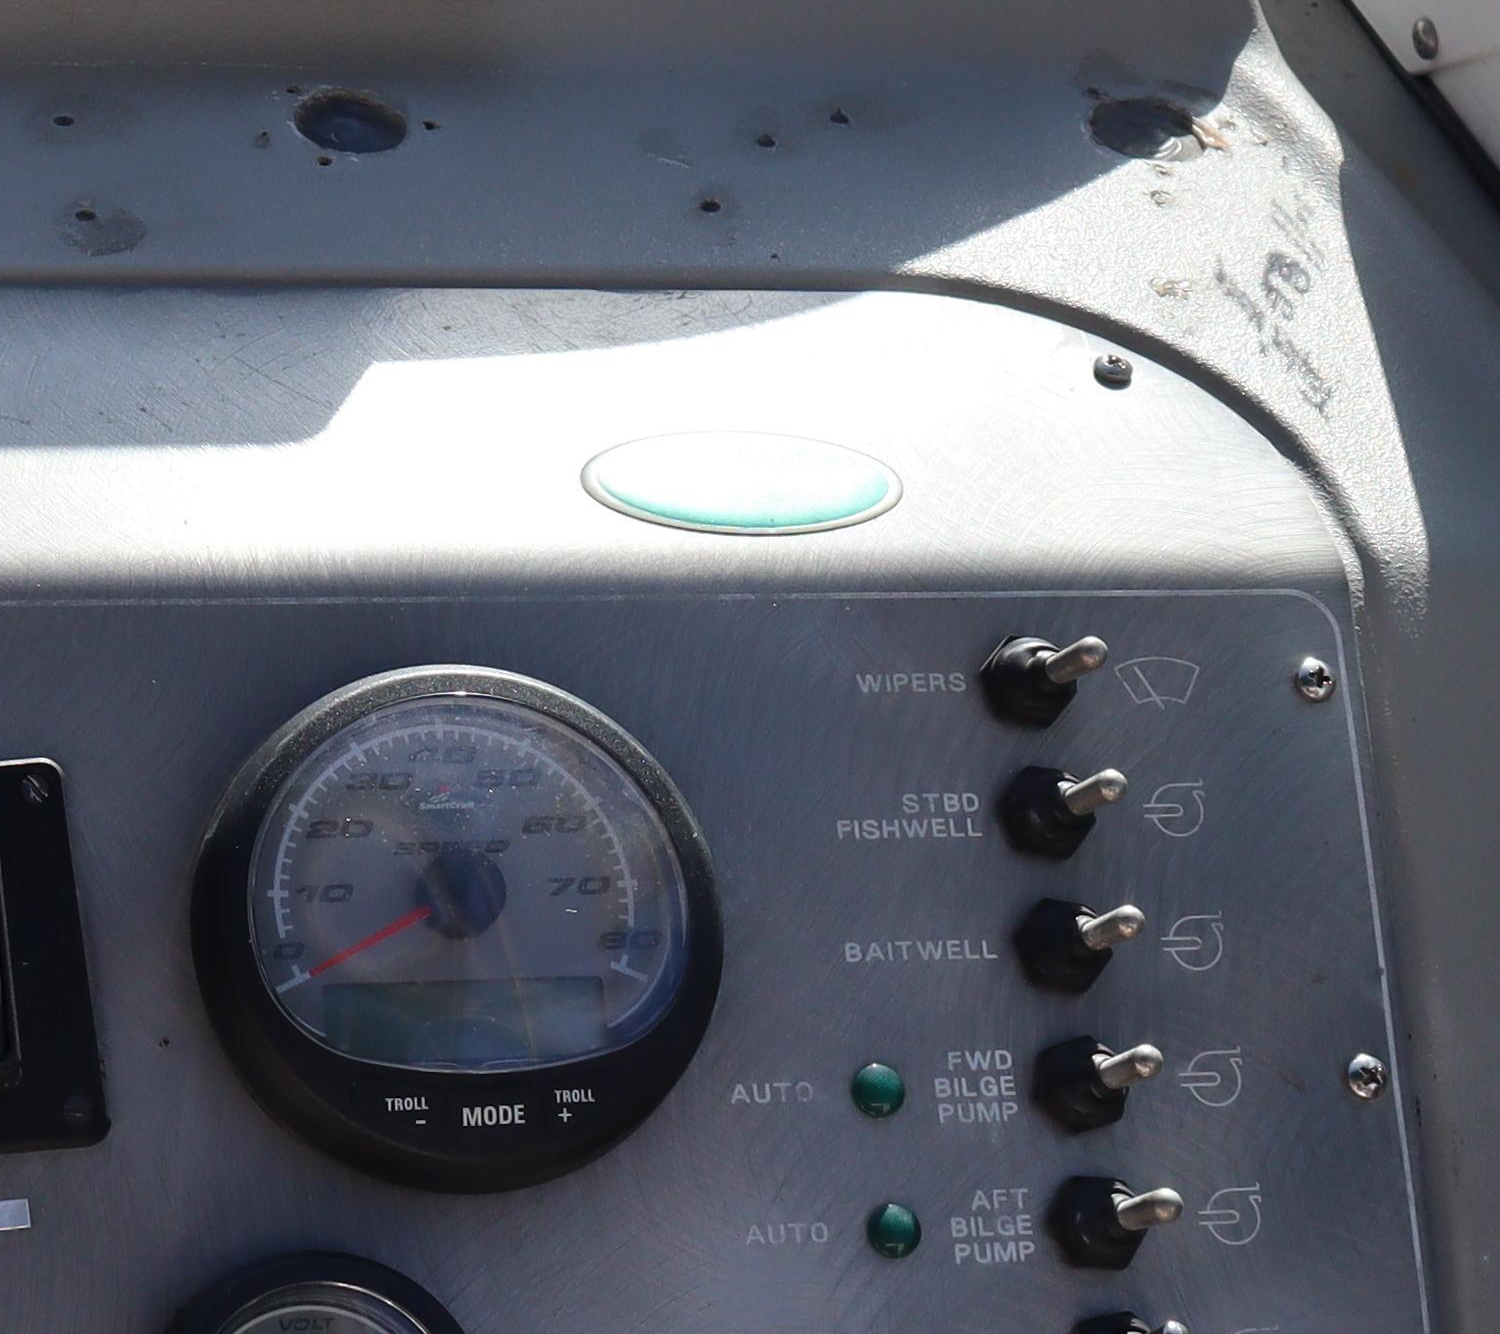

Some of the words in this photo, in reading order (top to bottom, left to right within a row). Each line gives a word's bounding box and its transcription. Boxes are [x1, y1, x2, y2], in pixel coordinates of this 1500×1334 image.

[856, 672, 967, 693] WIPERS
[902, 793, 980, 813] STBD
[305, 819, 374, 840] 20
[836, 818, 982, 840] FISHWELL
[296, 882, 355, 903] 10
[549, 875, 612, 896] 70
[272, 942, 305, 961] 0
[844, 939, 999, 963] BAITWELL
[948, 1050, 1013, 1070] FWD
[554, 1089, 595, 1104] TROLL
[731, 1082, 814, 1105] AUTO
[935, 1076, 1017, 1098] BILGE
[385, 1097, 429, 1112] TROLL
[938, 1101, 1018, 1124] PUMP
[462, 1104, 526, 1128] MODE
[972, 1188, 1028, 1210] AFT
[746, 1222, 830, 1245] AUTO
[951, 1214, 1034, 1238] BILGE
[954, 1241, 1035, 1265] PUMP
[278, 1316, 336, 1333] VOLT
